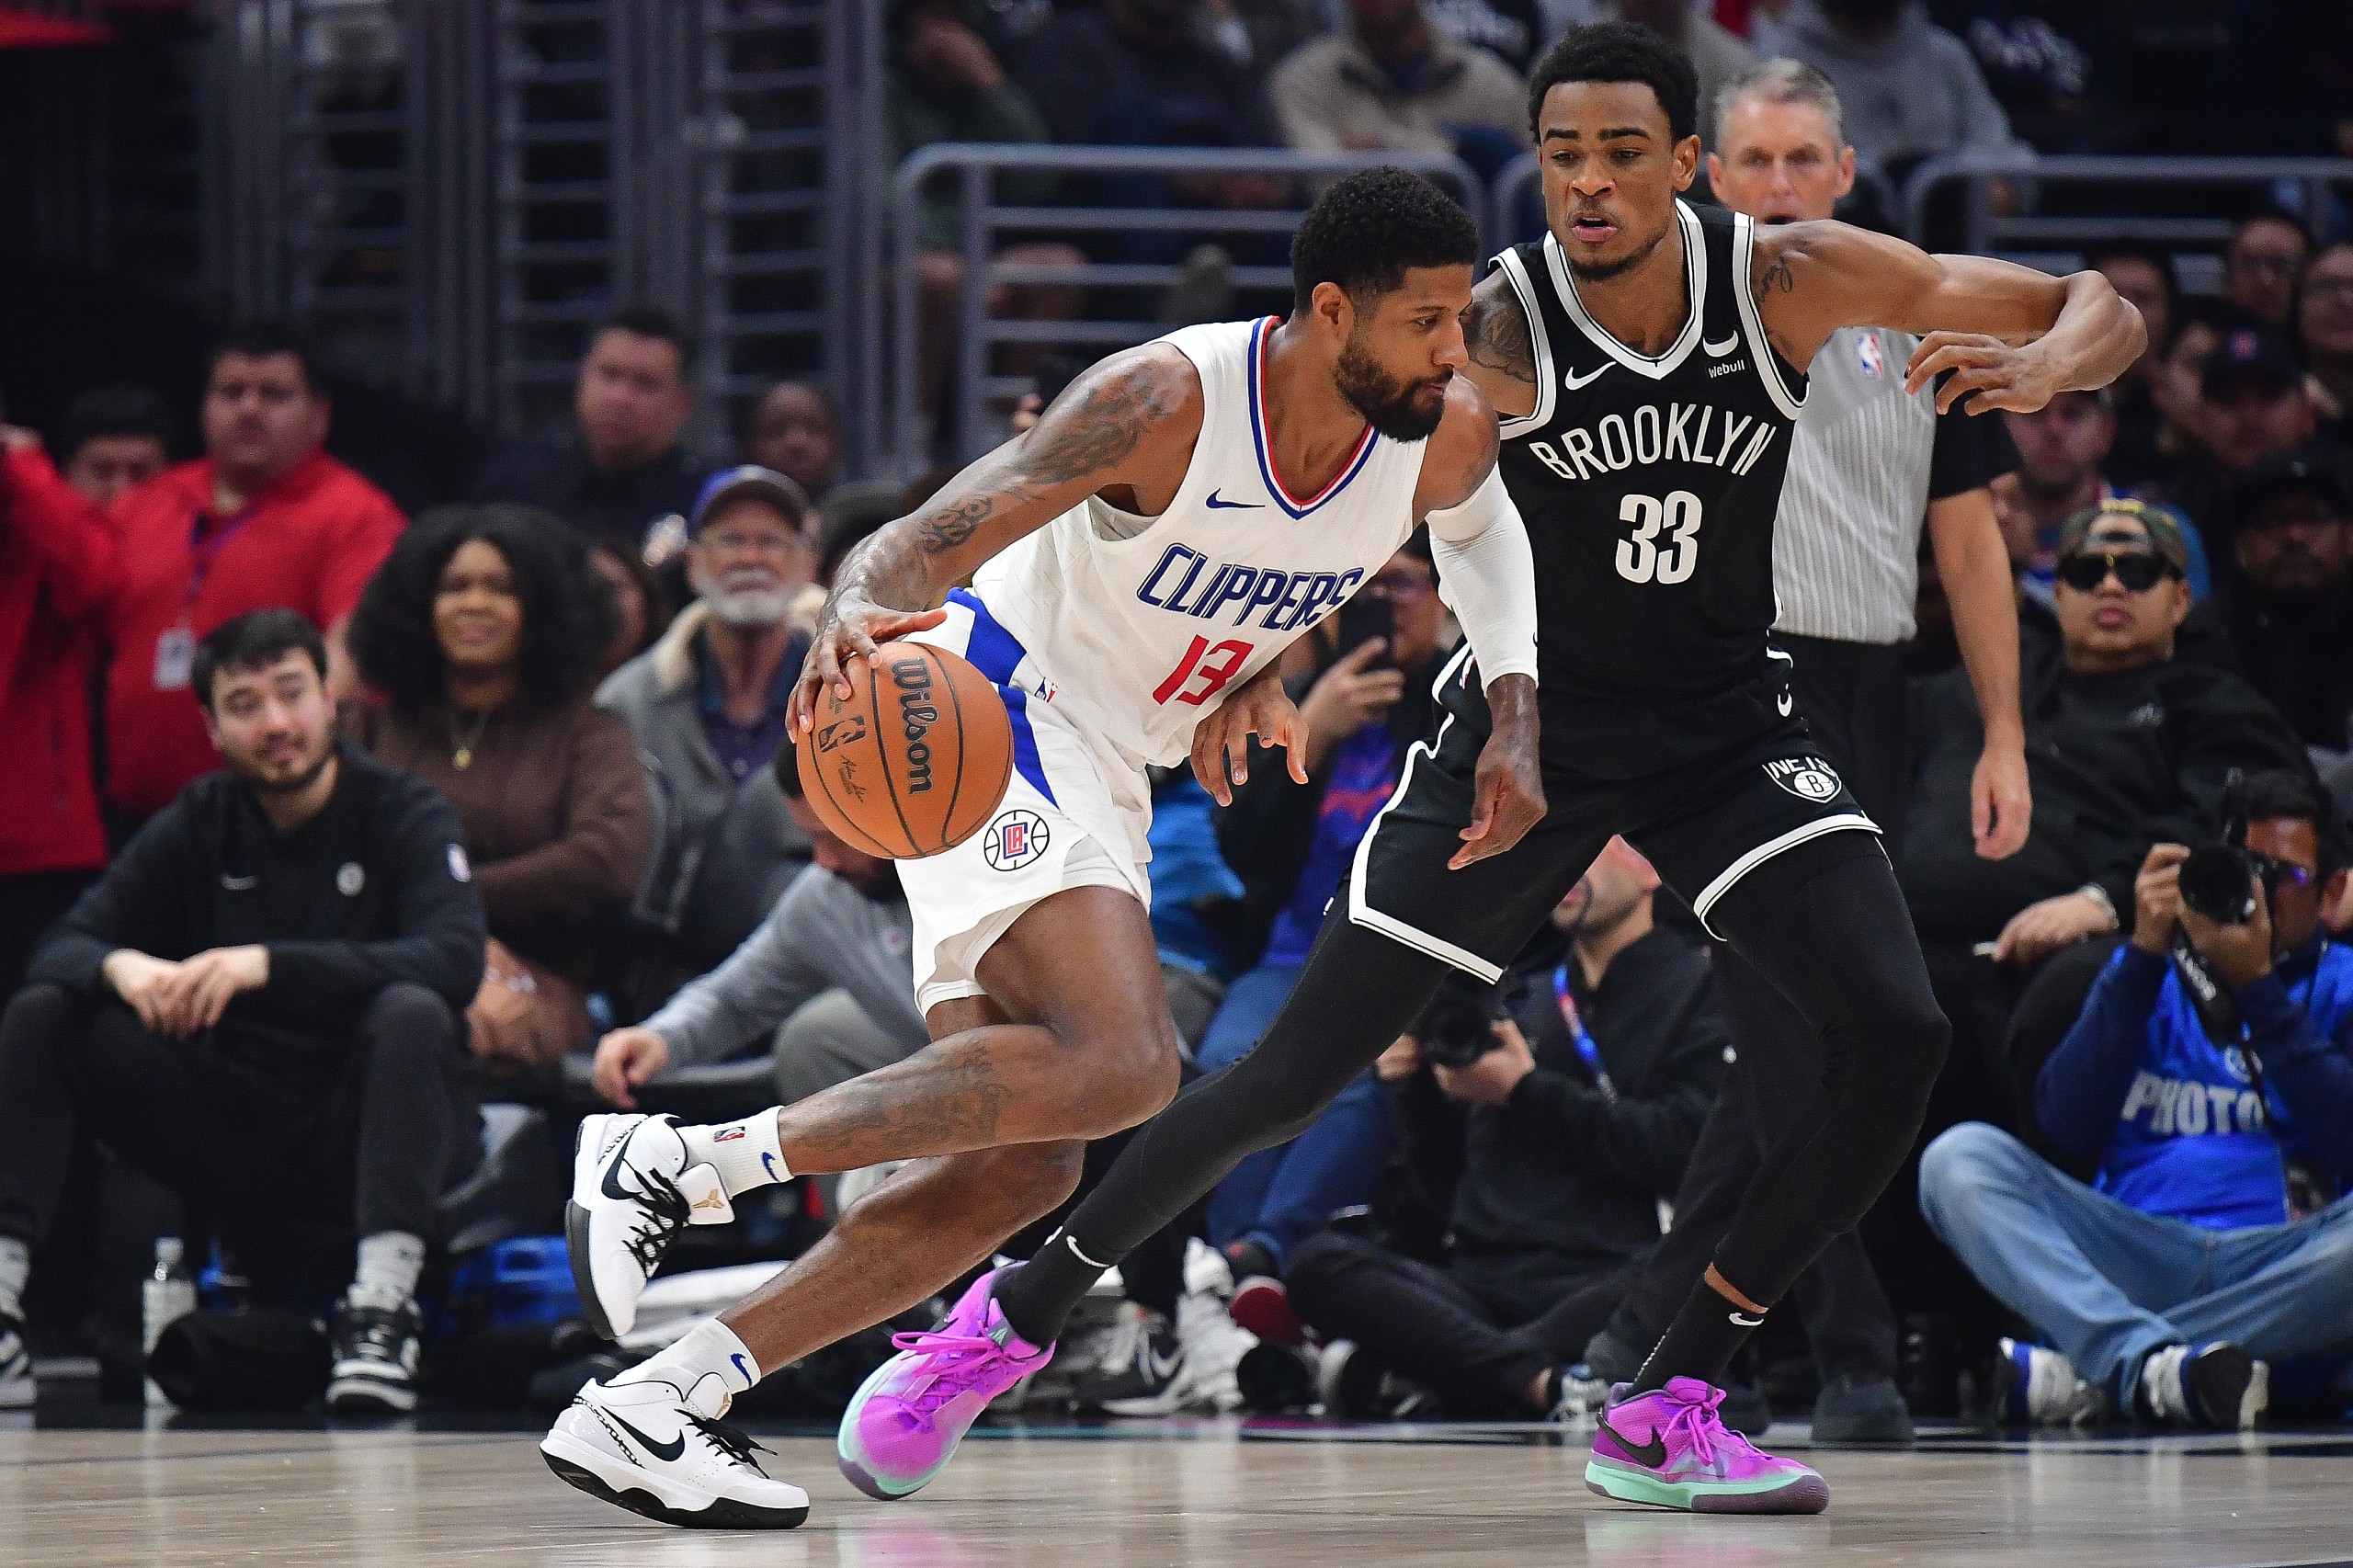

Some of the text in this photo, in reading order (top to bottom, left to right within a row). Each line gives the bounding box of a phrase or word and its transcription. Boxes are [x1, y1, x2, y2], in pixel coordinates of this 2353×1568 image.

[1708, 358, 1745, 379] Webull
[1529, 403, 1777, 480] BROOKLYN
[1615, 491, 1702, 585] 33
[1136, 542, 1365, 631] CLIPPERS
[1153, 634, 1255, 705] 13
[890, 656, 939, 795] Wilson
